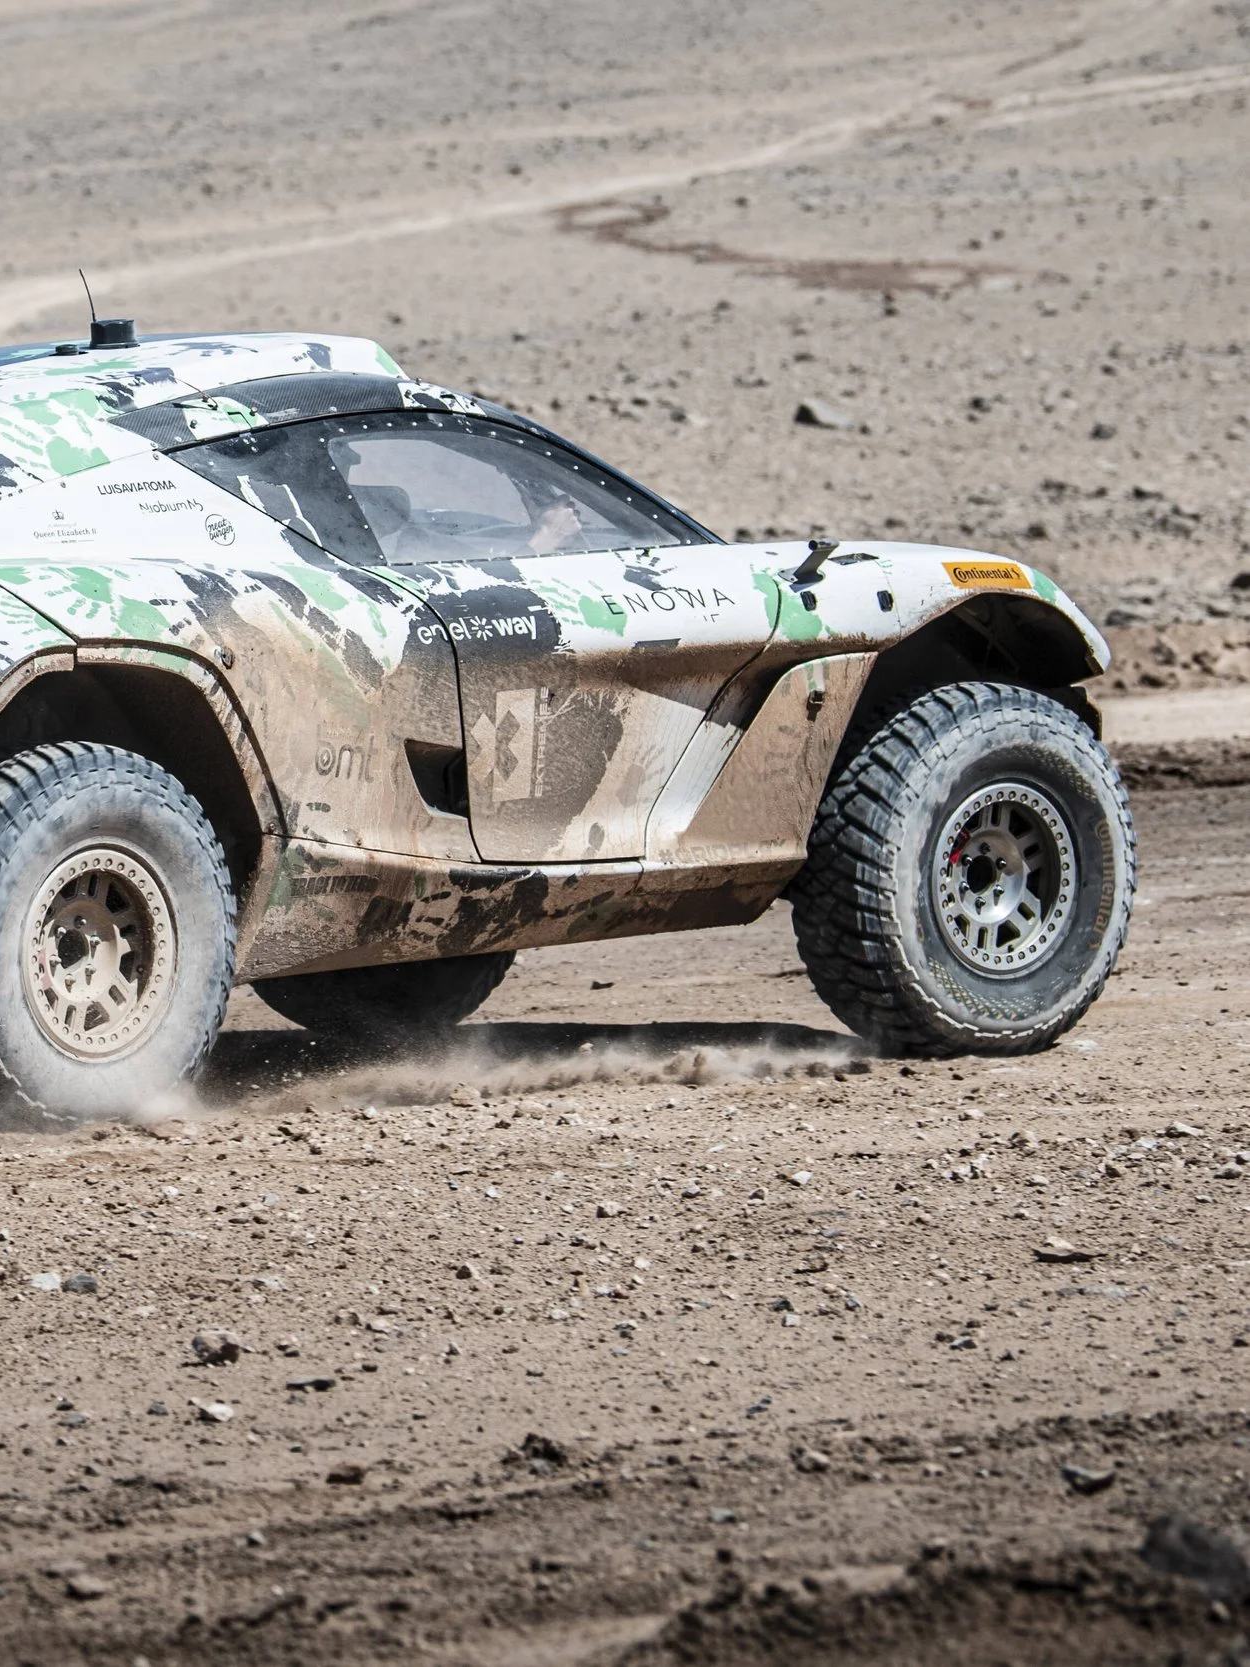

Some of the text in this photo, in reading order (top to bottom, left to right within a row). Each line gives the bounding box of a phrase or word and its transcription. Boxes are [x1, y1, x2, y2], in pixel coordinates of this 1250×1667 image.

[97, 480, 177, 496] LUISAVIAROMA
[208, 518, 228, 532] neat
[209, 525, 234, 541] burger
[33, 530, 56, 540] Queen
[57, 527, 90, 538] Elizabeth
[953, 567, 1013, 584] Continental
[601, 587, 736, 616] ENOWA
[416, 615, 537, 645] enel way
